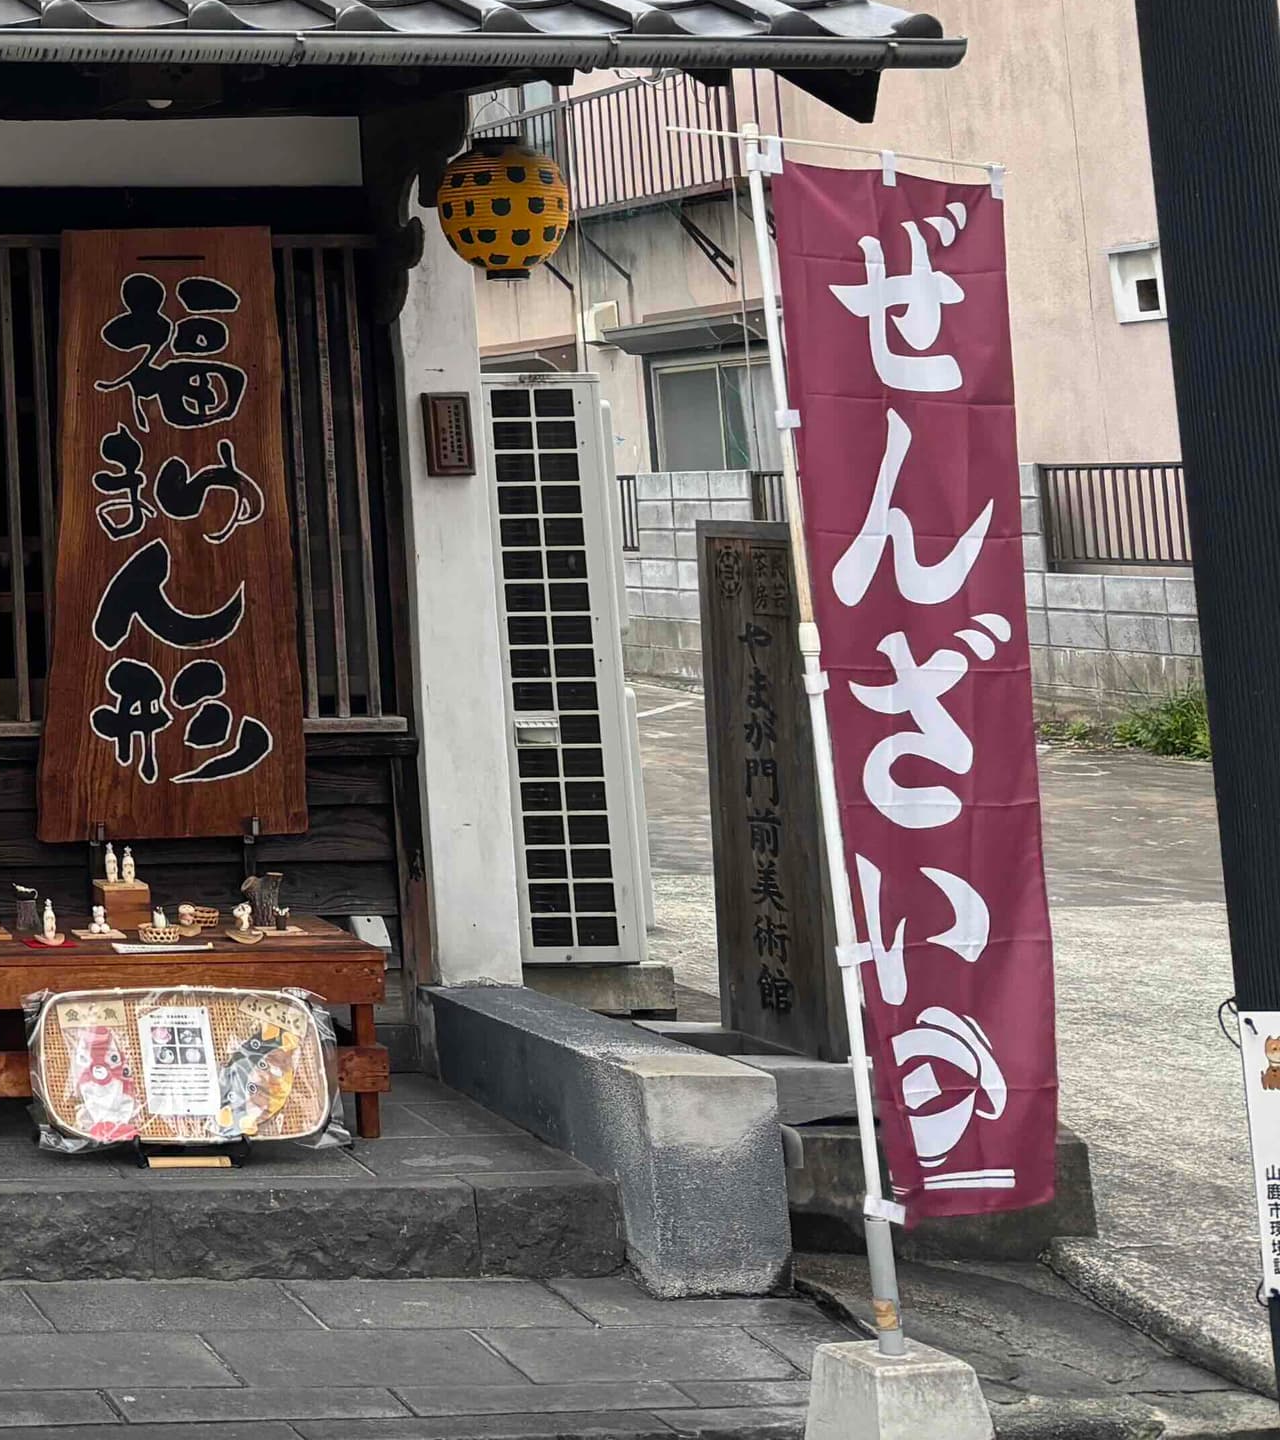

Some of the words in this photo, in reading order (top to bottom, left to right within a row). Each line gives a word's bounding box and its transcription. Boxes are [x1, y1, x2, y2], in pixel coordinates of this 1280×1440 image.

[739, 621, 794, 1016] やまが門前美術館
[828, 202, 1013, 1007] ぜんざい
